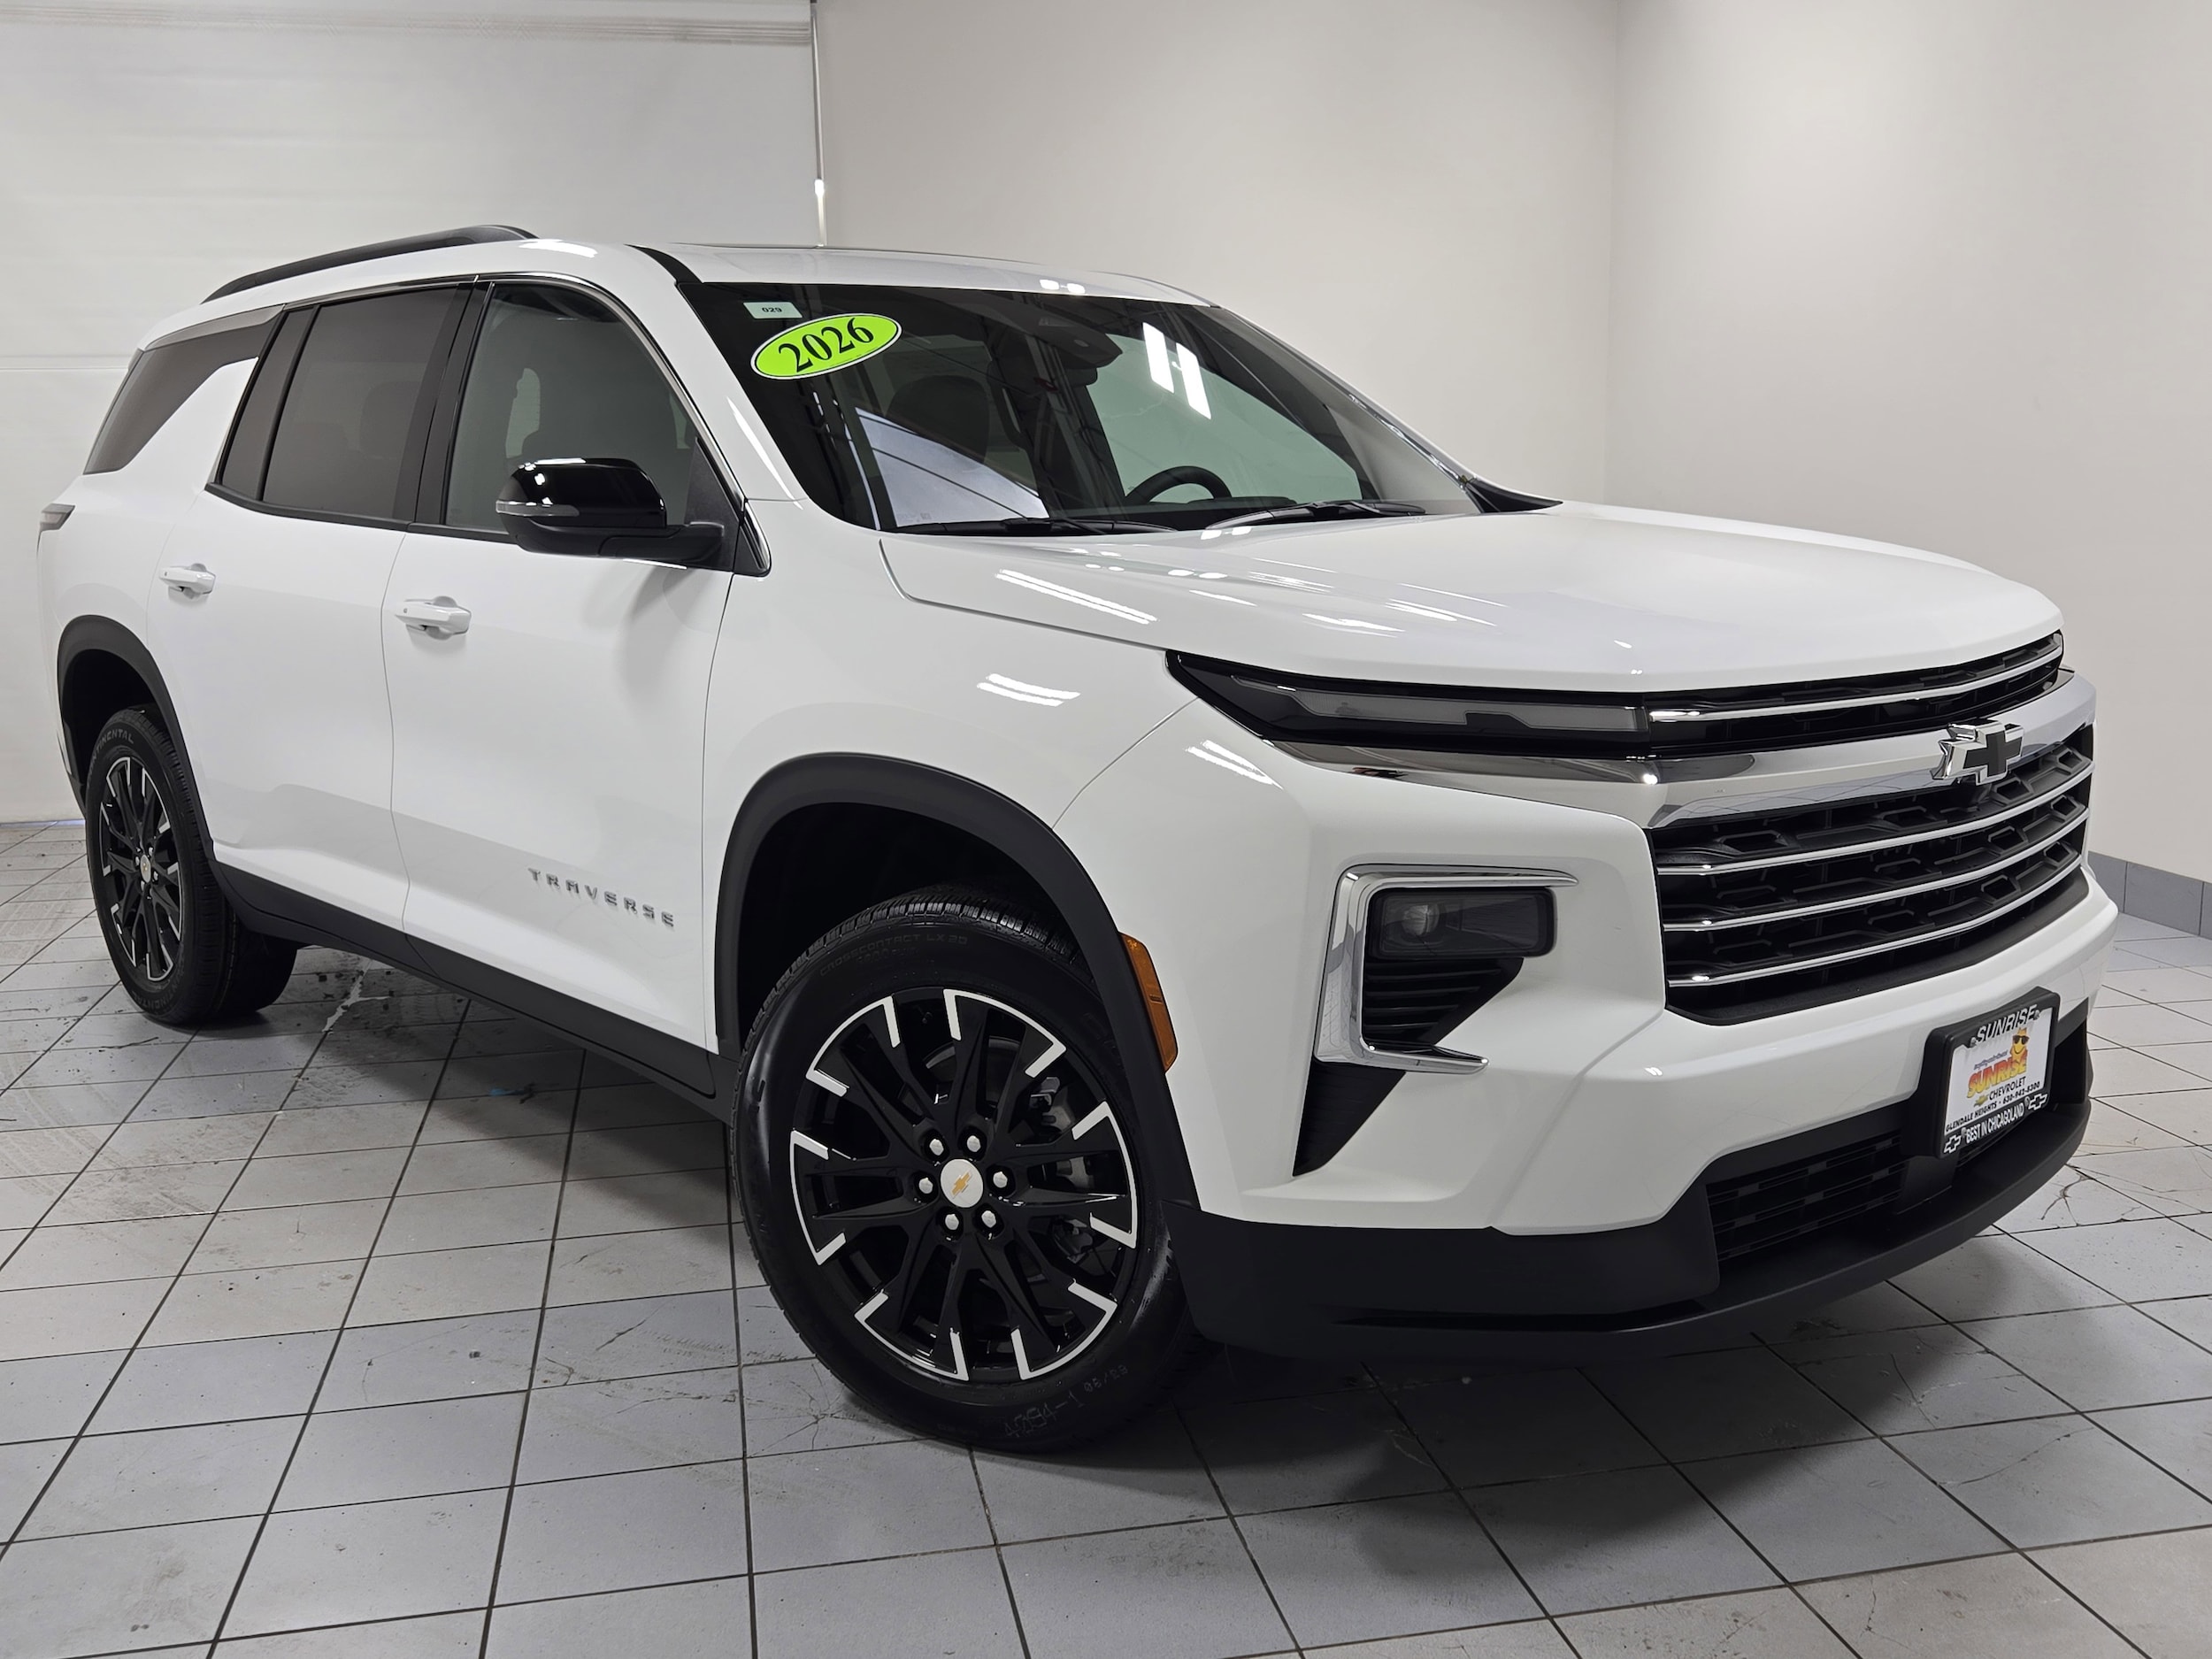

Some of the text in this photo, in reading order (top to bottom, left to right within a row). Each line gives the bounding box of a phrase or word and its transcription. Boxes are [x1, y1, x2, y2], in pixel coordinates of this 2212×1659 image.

[778, 318, 874, 373] 2026
[527, 867, 674, 927] TRAVERSE
[1976, 1004, 2038, 1043] SUNRISE
[1966, 1051, 2028, 1098] SUNRISE
[1989, 1076, 2026, 1101] CHEVROLET
[1946, 1111, 1974, 1133] GLENDALE
[1974, 1100, 1997, 1119] HEIGHTS
[1966, 1102, 2024, 1144] BEST IN CHICAGOLAND
